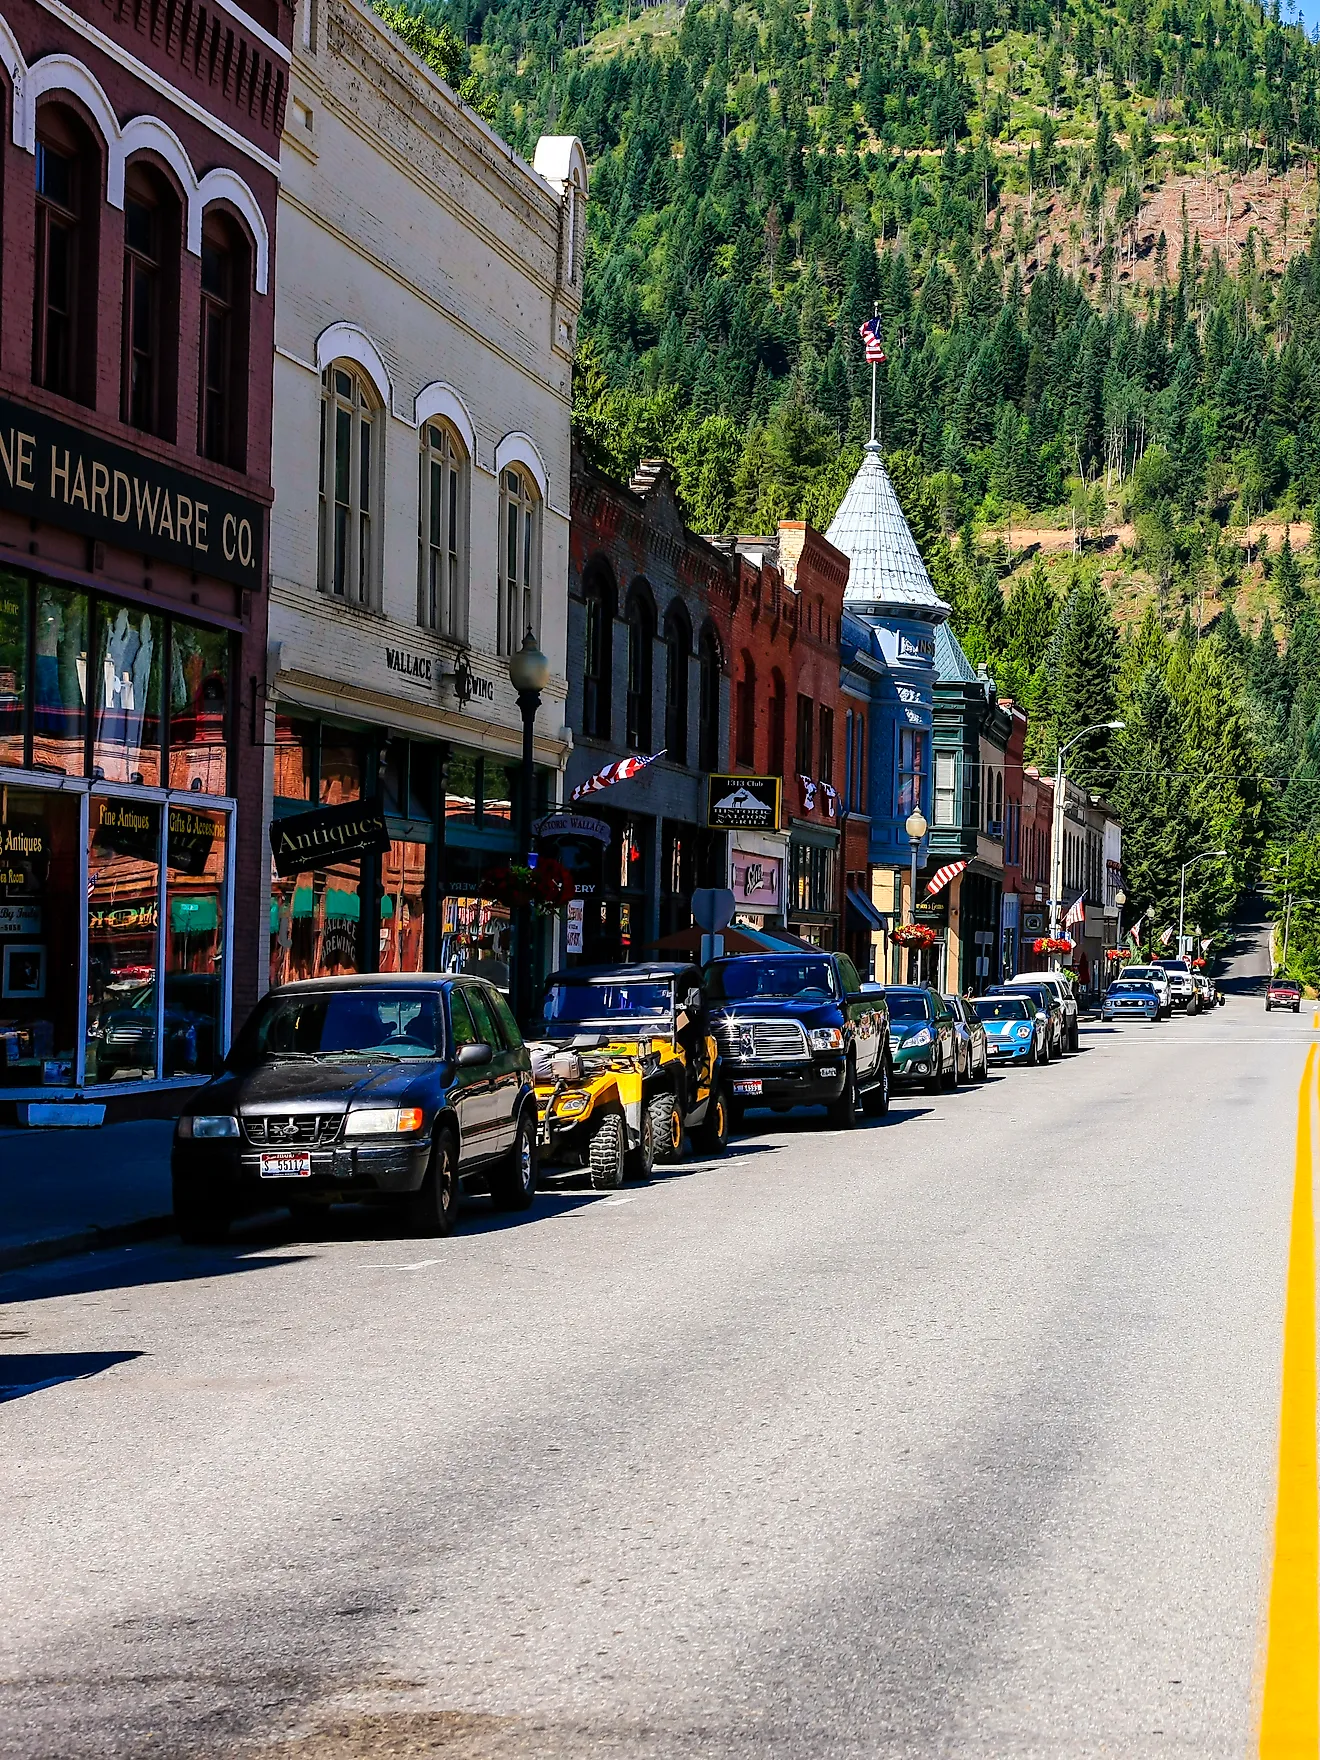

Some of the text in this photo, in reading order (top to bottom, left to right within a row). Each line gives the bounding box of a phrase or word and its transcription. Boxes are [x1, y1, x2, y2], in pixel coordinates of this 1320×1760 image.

[50, 444, 210, 552] HARDWARE
[222, 512, 256, 568] CO.
[385, 647, 432, 681] WALLACE
[727, 779, 745, 787] 1313
[99, 803, 150, 832] Fine Antiques
[169, 812, 185, 833] Gifts
[186, 814, 192, 833] &
[570, 818, 606, 834] WALLACE
[5, 829, 43, 856] Antiques
[278, 816, 384, 854] Antiques
[8, 869, 24, 884] Room
[574, 884, 596, 893] ERY
[264, 1159, 304, 1171] S 55112
